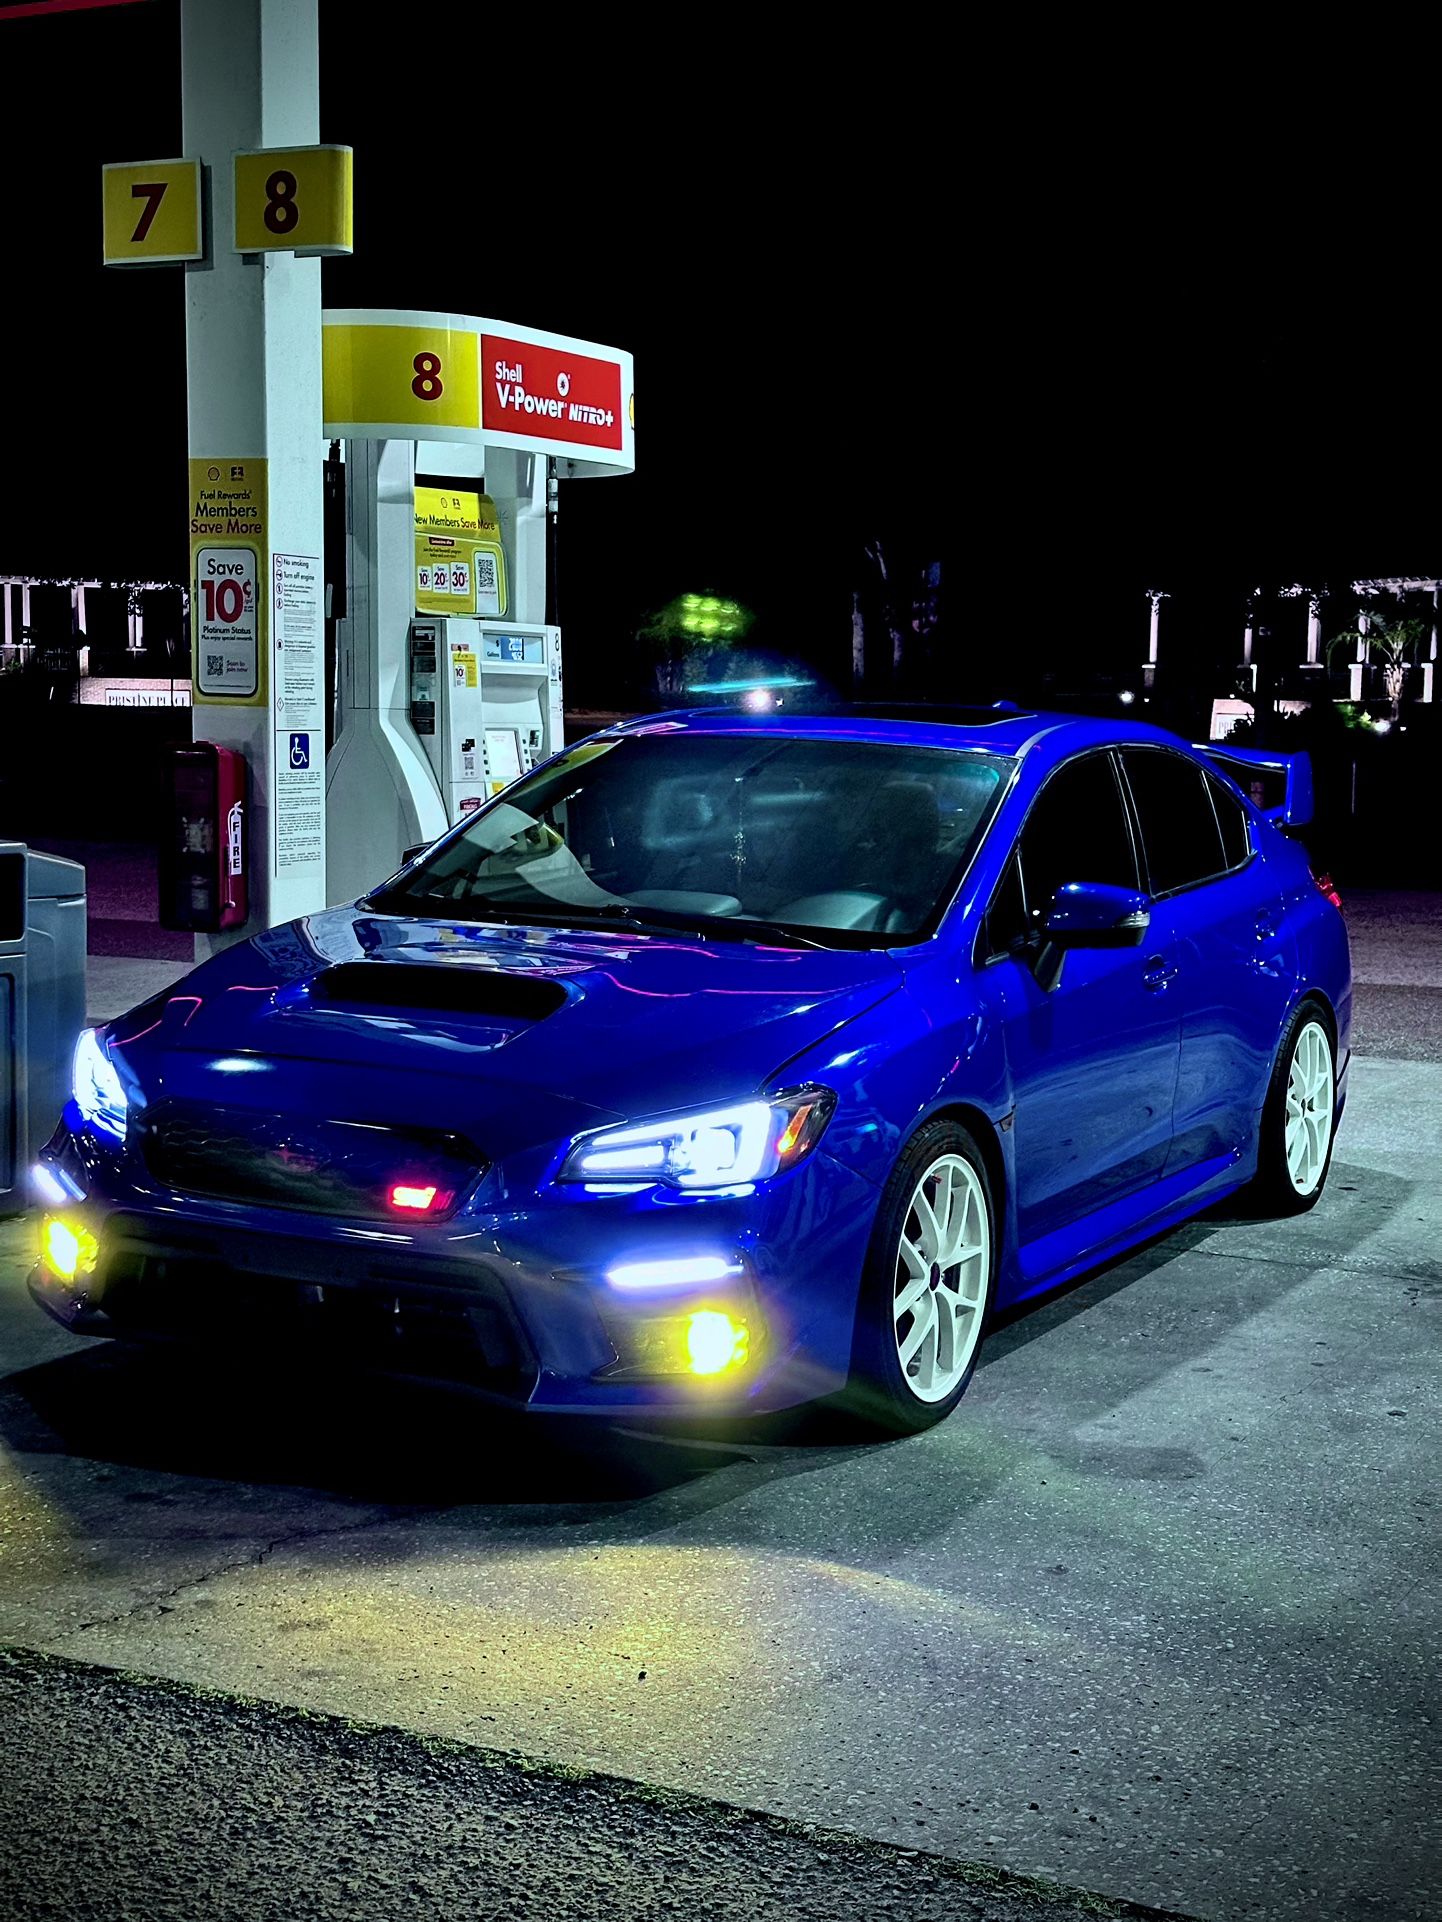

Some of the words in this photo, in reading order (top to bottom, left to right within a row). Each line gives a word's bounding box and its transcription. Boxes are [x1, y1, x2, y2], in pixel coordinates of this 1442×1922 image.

[264, 170, 299, 234] 8
[130, 182, 168, 242] 7
[411, 351, 444, 401] 8
[495, 361, 523, 384] Shell
[495, 382, 565, 419] V-Power
[200, 490, 216, 500] Fuel
[195, 501, 258, 518] Members
[191, 519, 223, 534] Save
[226, 519, 263, 534] More
[429, 514, 460, 528] Members
[460, 517, 477, 529] Save
[478, 518, 496, 531] More
[207, 558, 244, 575] Save
[283, 558, 291, 566] No
[291, 560, 310, 570] smoking
[283, 571, 293, 579] Turn
[300, 574, 315, 582] engine
[202, 625, 230, 634] Platinum
[231, 626, 252, 635] Status
[232, 821, 241, 869] FIRE
